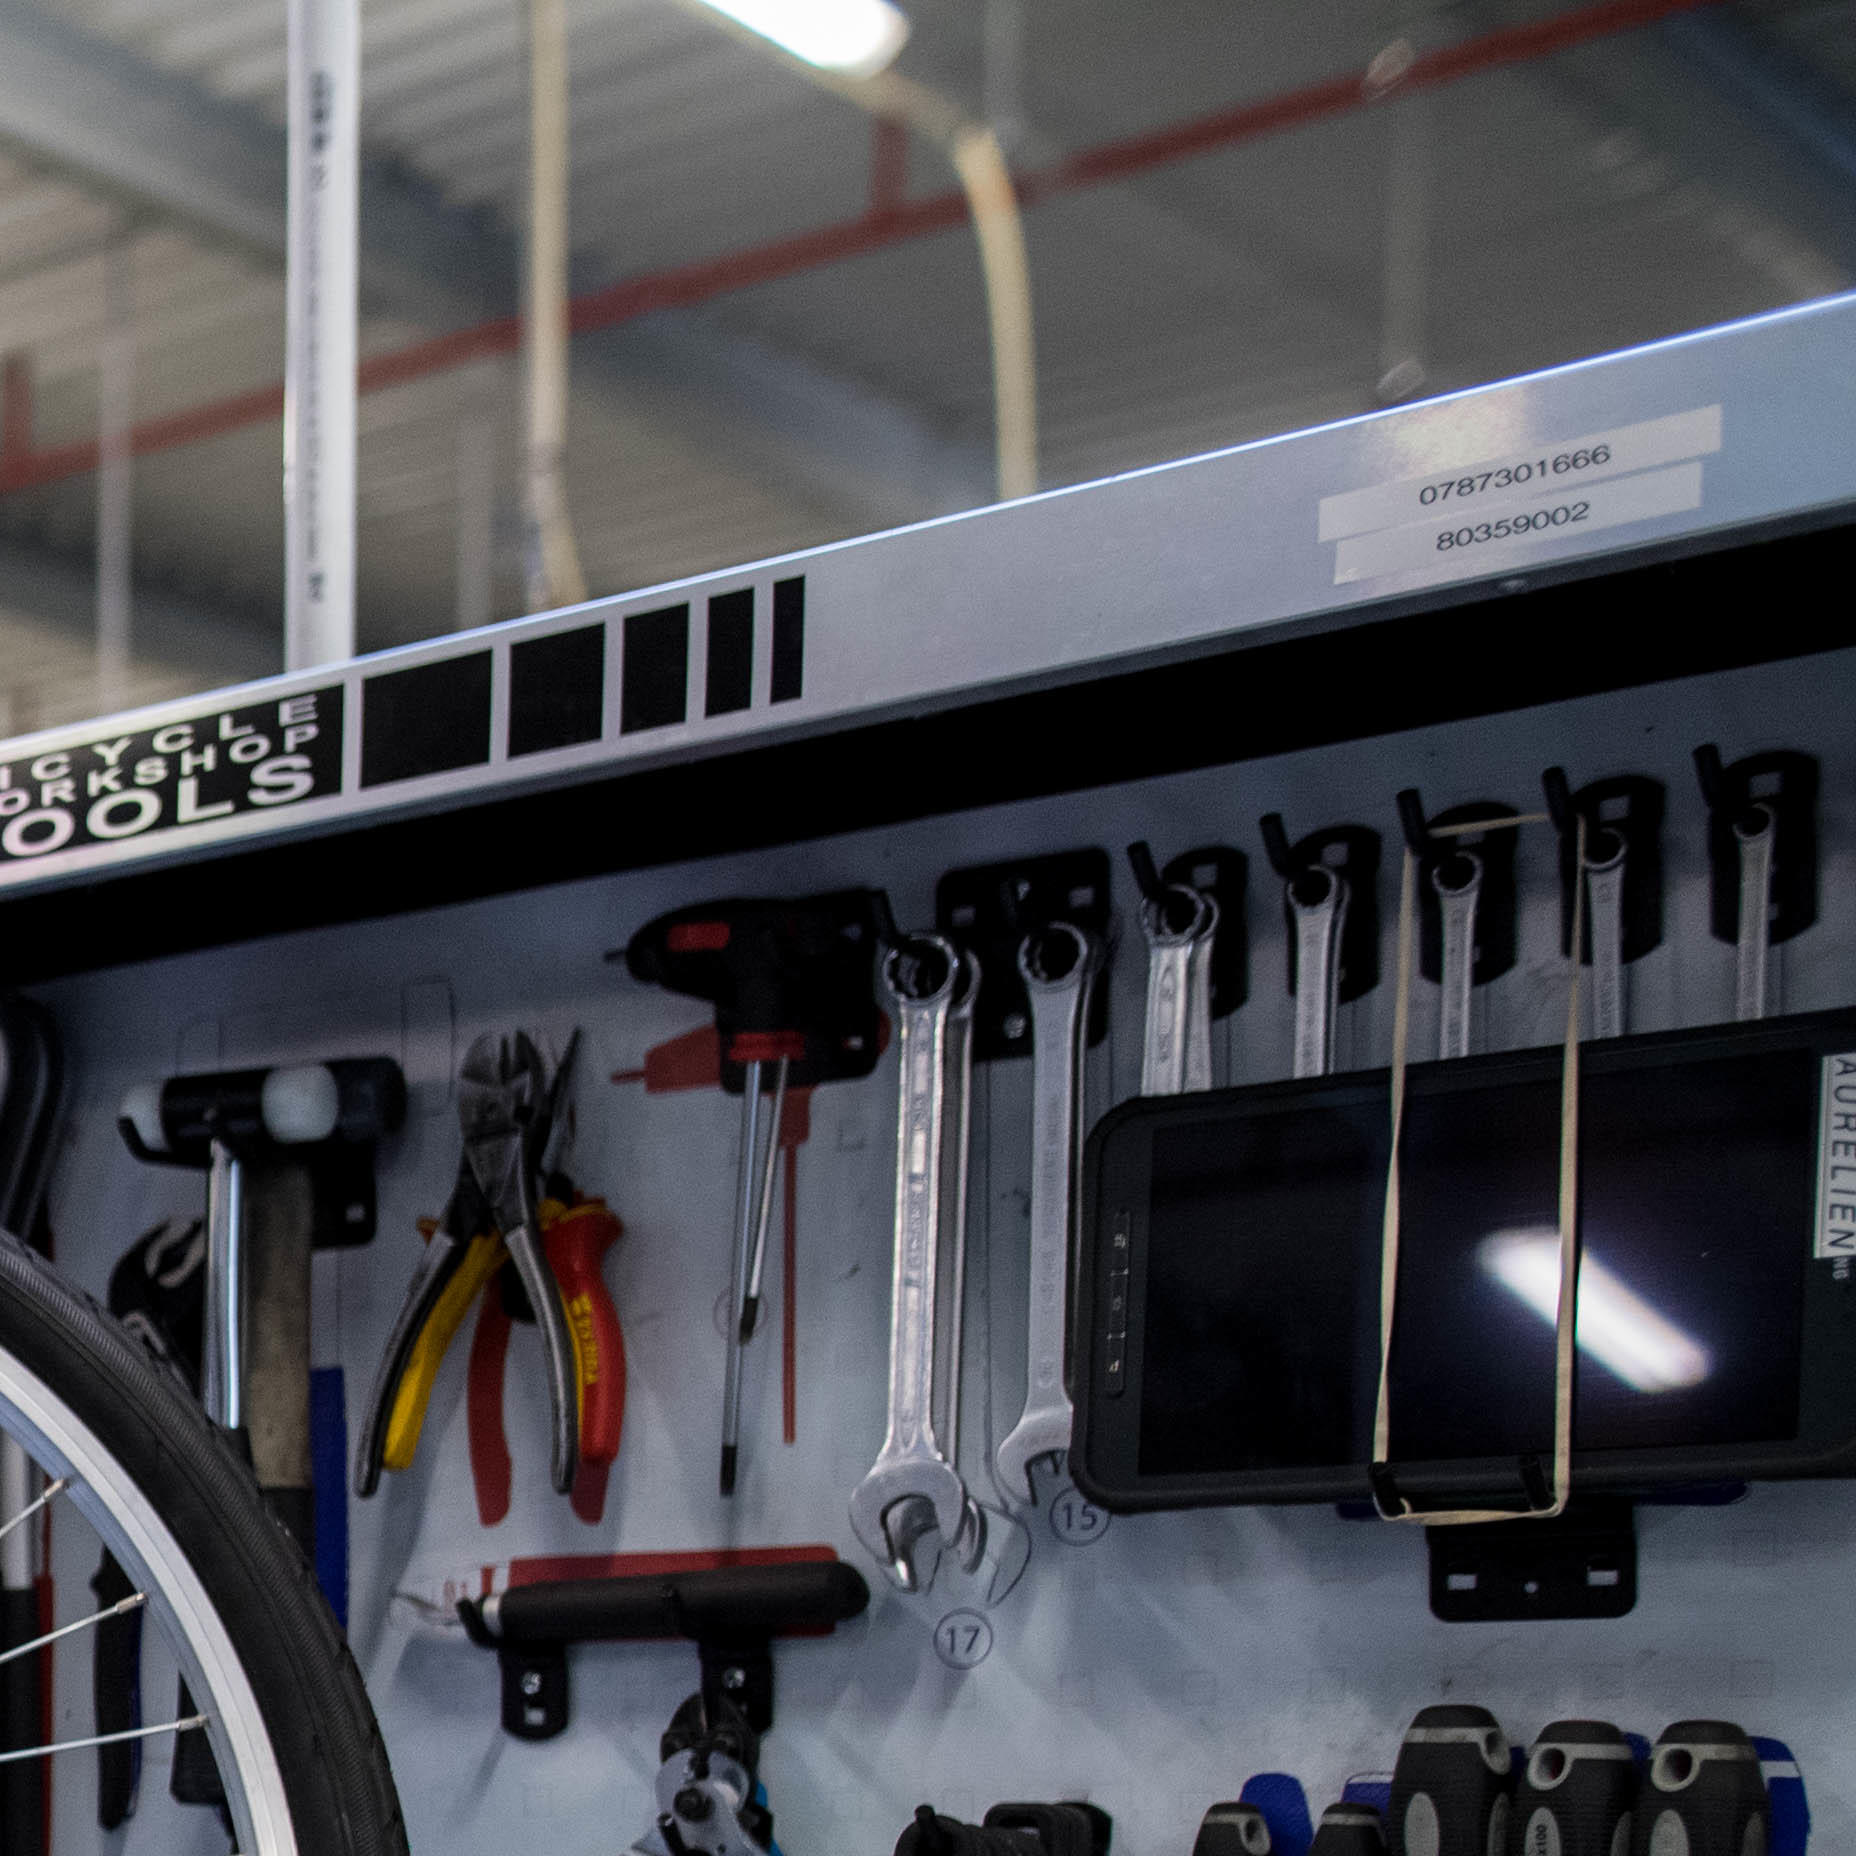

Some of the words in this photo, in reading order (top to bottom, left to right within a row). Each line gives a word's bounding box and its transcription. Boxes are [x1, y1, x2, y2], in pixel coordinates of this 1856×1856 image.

[1419, 444, 1611, 505] 0787301666
[1436, 502, 1590, 551] 80359002
[1064, 1503, 1097, 1531] 15
[947, 1626, 981, 1654] 17
